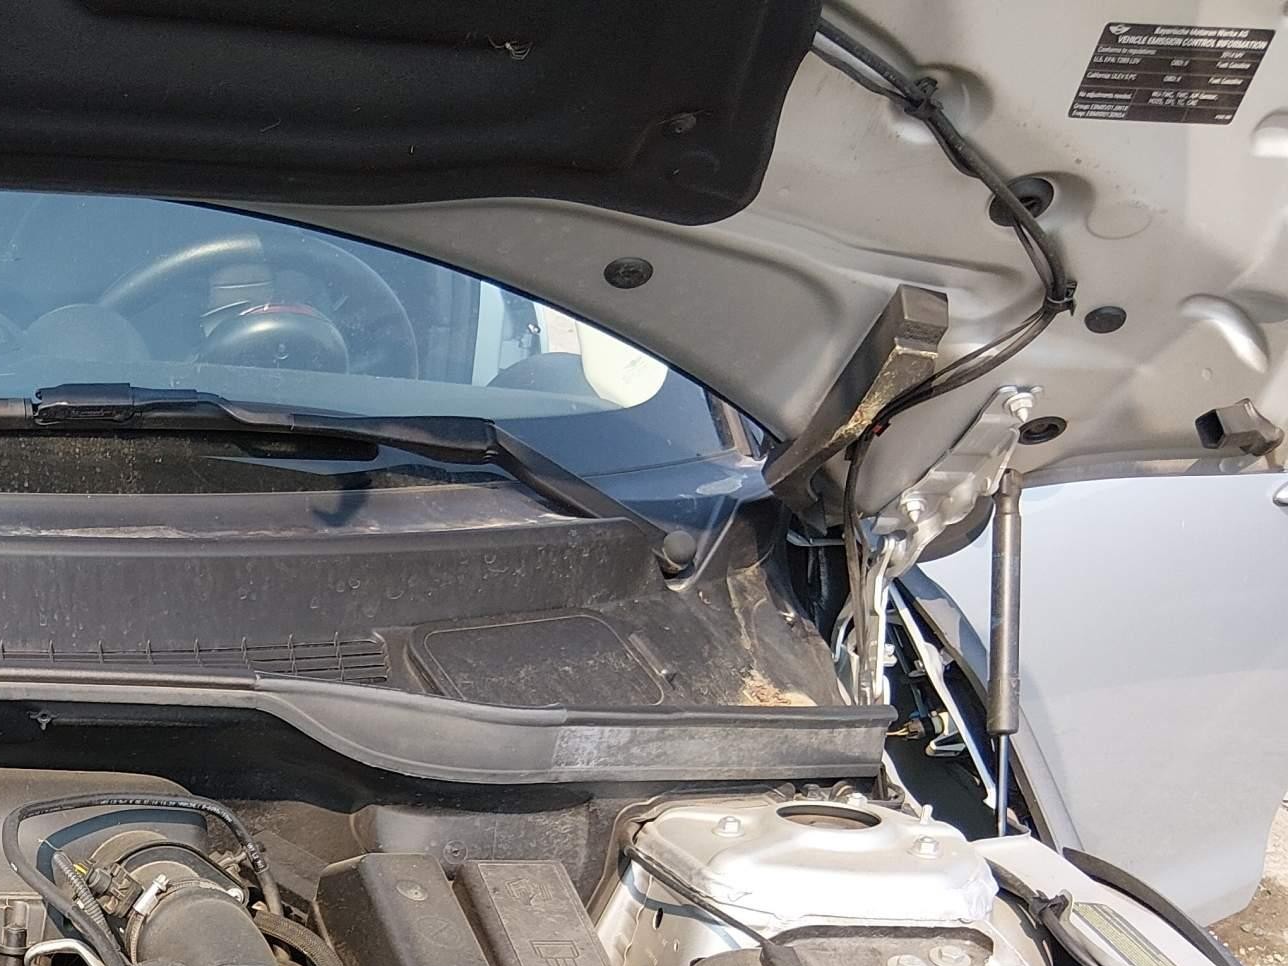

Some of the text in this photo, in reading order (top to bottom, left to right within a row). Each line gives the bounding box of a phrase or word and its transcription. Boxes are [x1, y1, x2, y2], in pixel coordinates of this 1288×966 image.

[1118, 36, 1268, 50] VEHICLE EMISSION CONTROL INFORMATION
